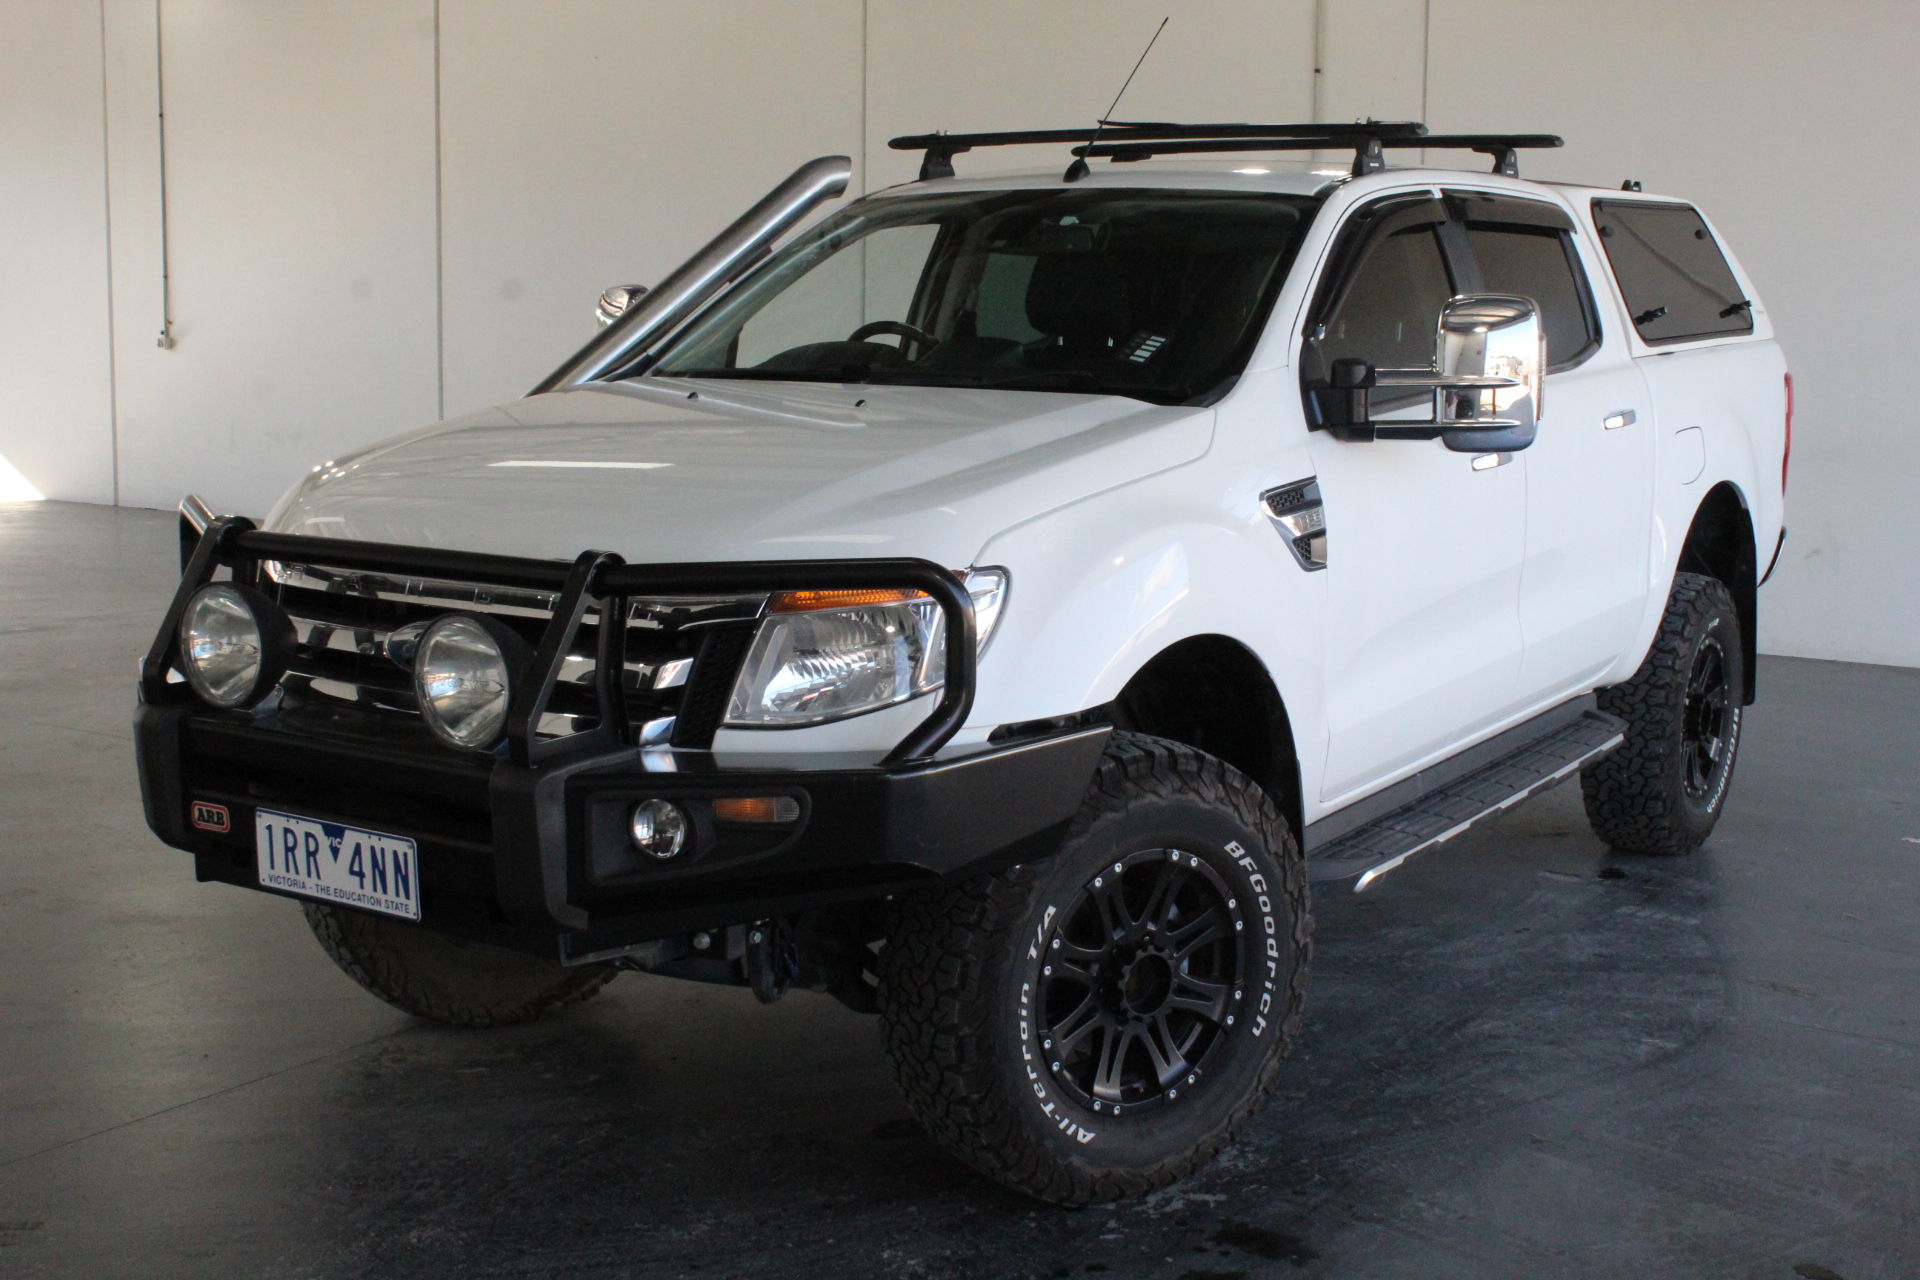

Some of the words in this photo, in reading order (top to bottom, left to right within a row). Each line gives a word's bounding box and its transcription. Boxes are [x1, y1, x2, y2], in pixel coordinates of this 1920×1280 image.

[197, 807, 225, 826] ARB
[327, 836, 343, 849] VIC
[265, 823, 322, 880] 1RR
[348, 842, 411, 901] 4NN
[267, 873, 307, 890] VICTORIA
[315, 884, 331, 896] THE
[333, 888, 382, 907] EDUCATION
[384, 899, 410, 914] STATE
[1027, 905, 1057, 960] T/A
[1223, 840, 1280, 1037] BFGoodrich
[1018, 982, 1096, 1144] All-Terrain
